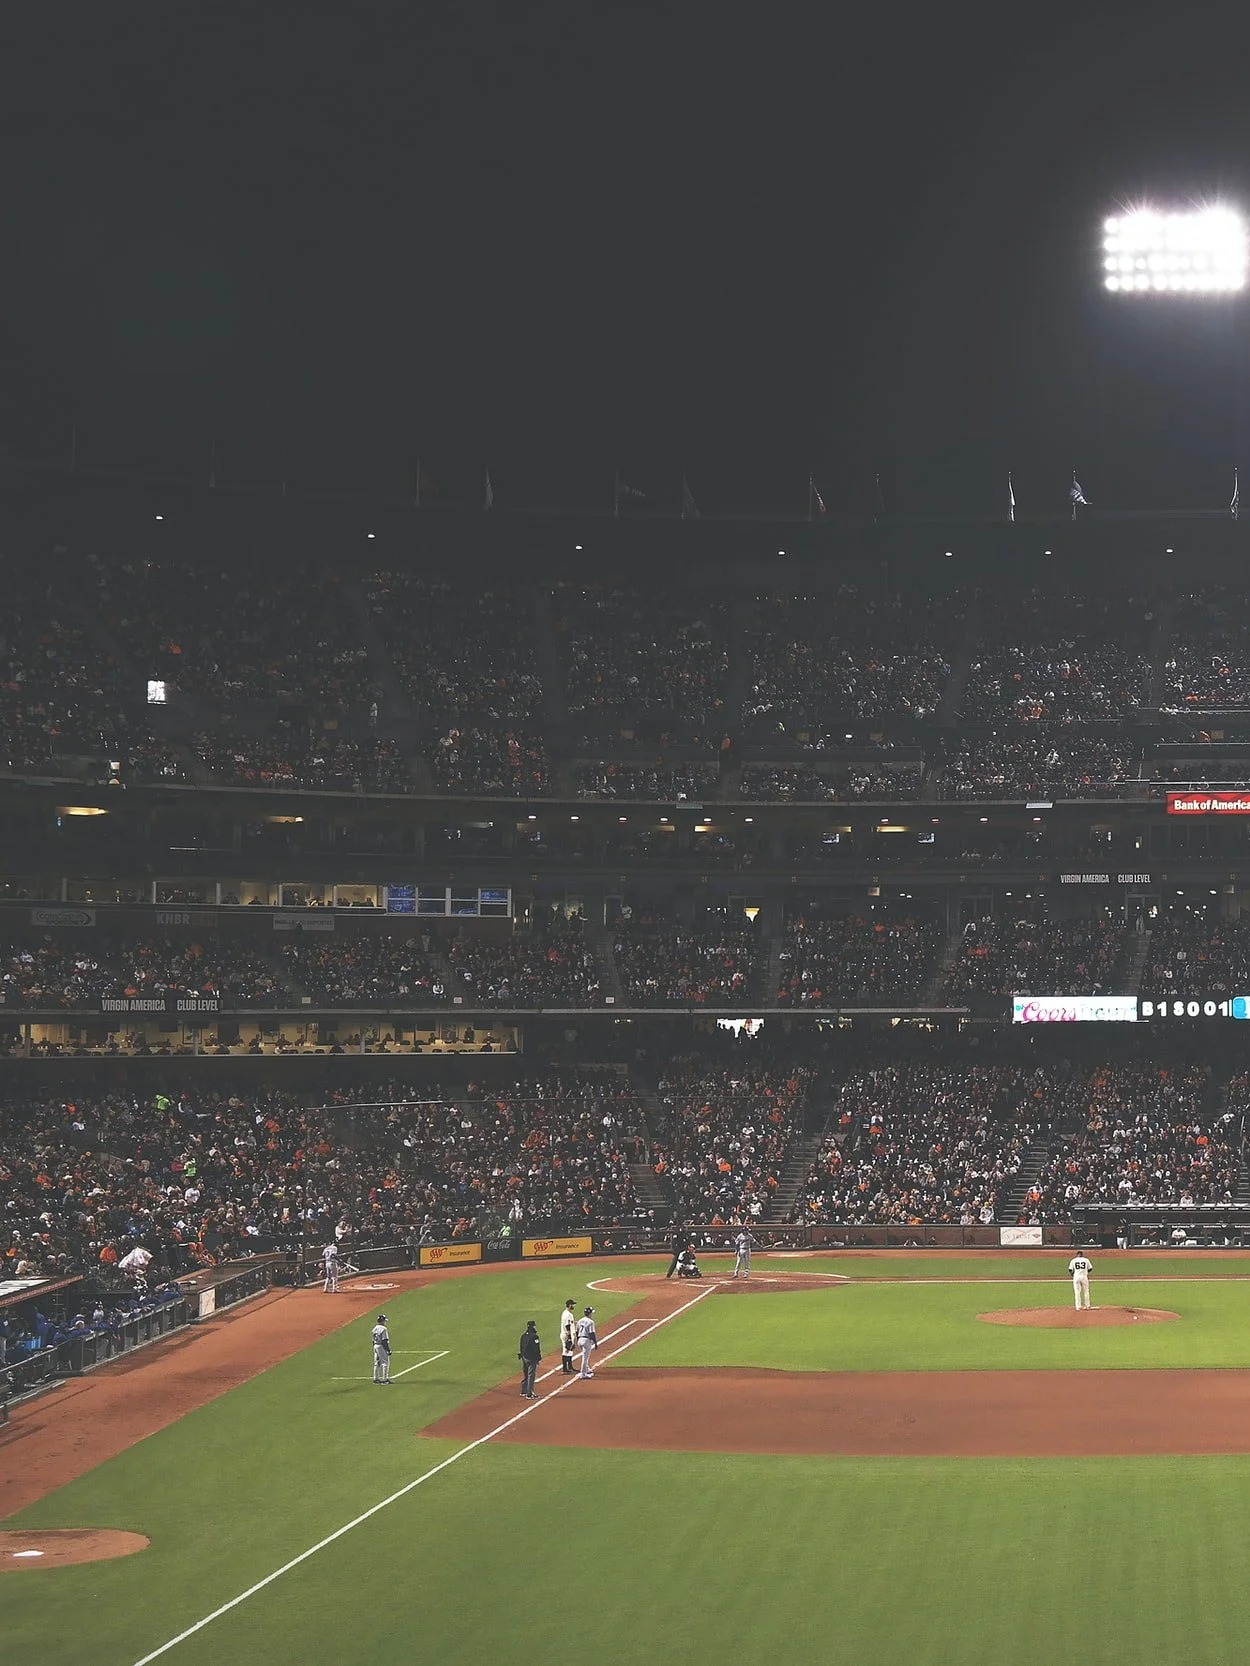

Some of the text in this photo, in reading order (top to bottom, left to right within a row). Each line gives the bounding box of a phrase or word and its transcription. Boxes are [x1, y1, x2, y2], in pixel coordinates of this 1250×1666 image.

[1174, 799, 1200, 810] Bank
[1200, 799, 1213, 810] of
[1060, 874, 1152, 884] VIRGIN AMERICA CLUB LEVEL
[156, 913, 190, 925] KNBR
[101, 999, 219, 1011] VIRGIN AMERICA CLUB LEVEL
[1022, 1001, 1076, 1021] Coors
[1075, 1261, 1086, 1270] 63
